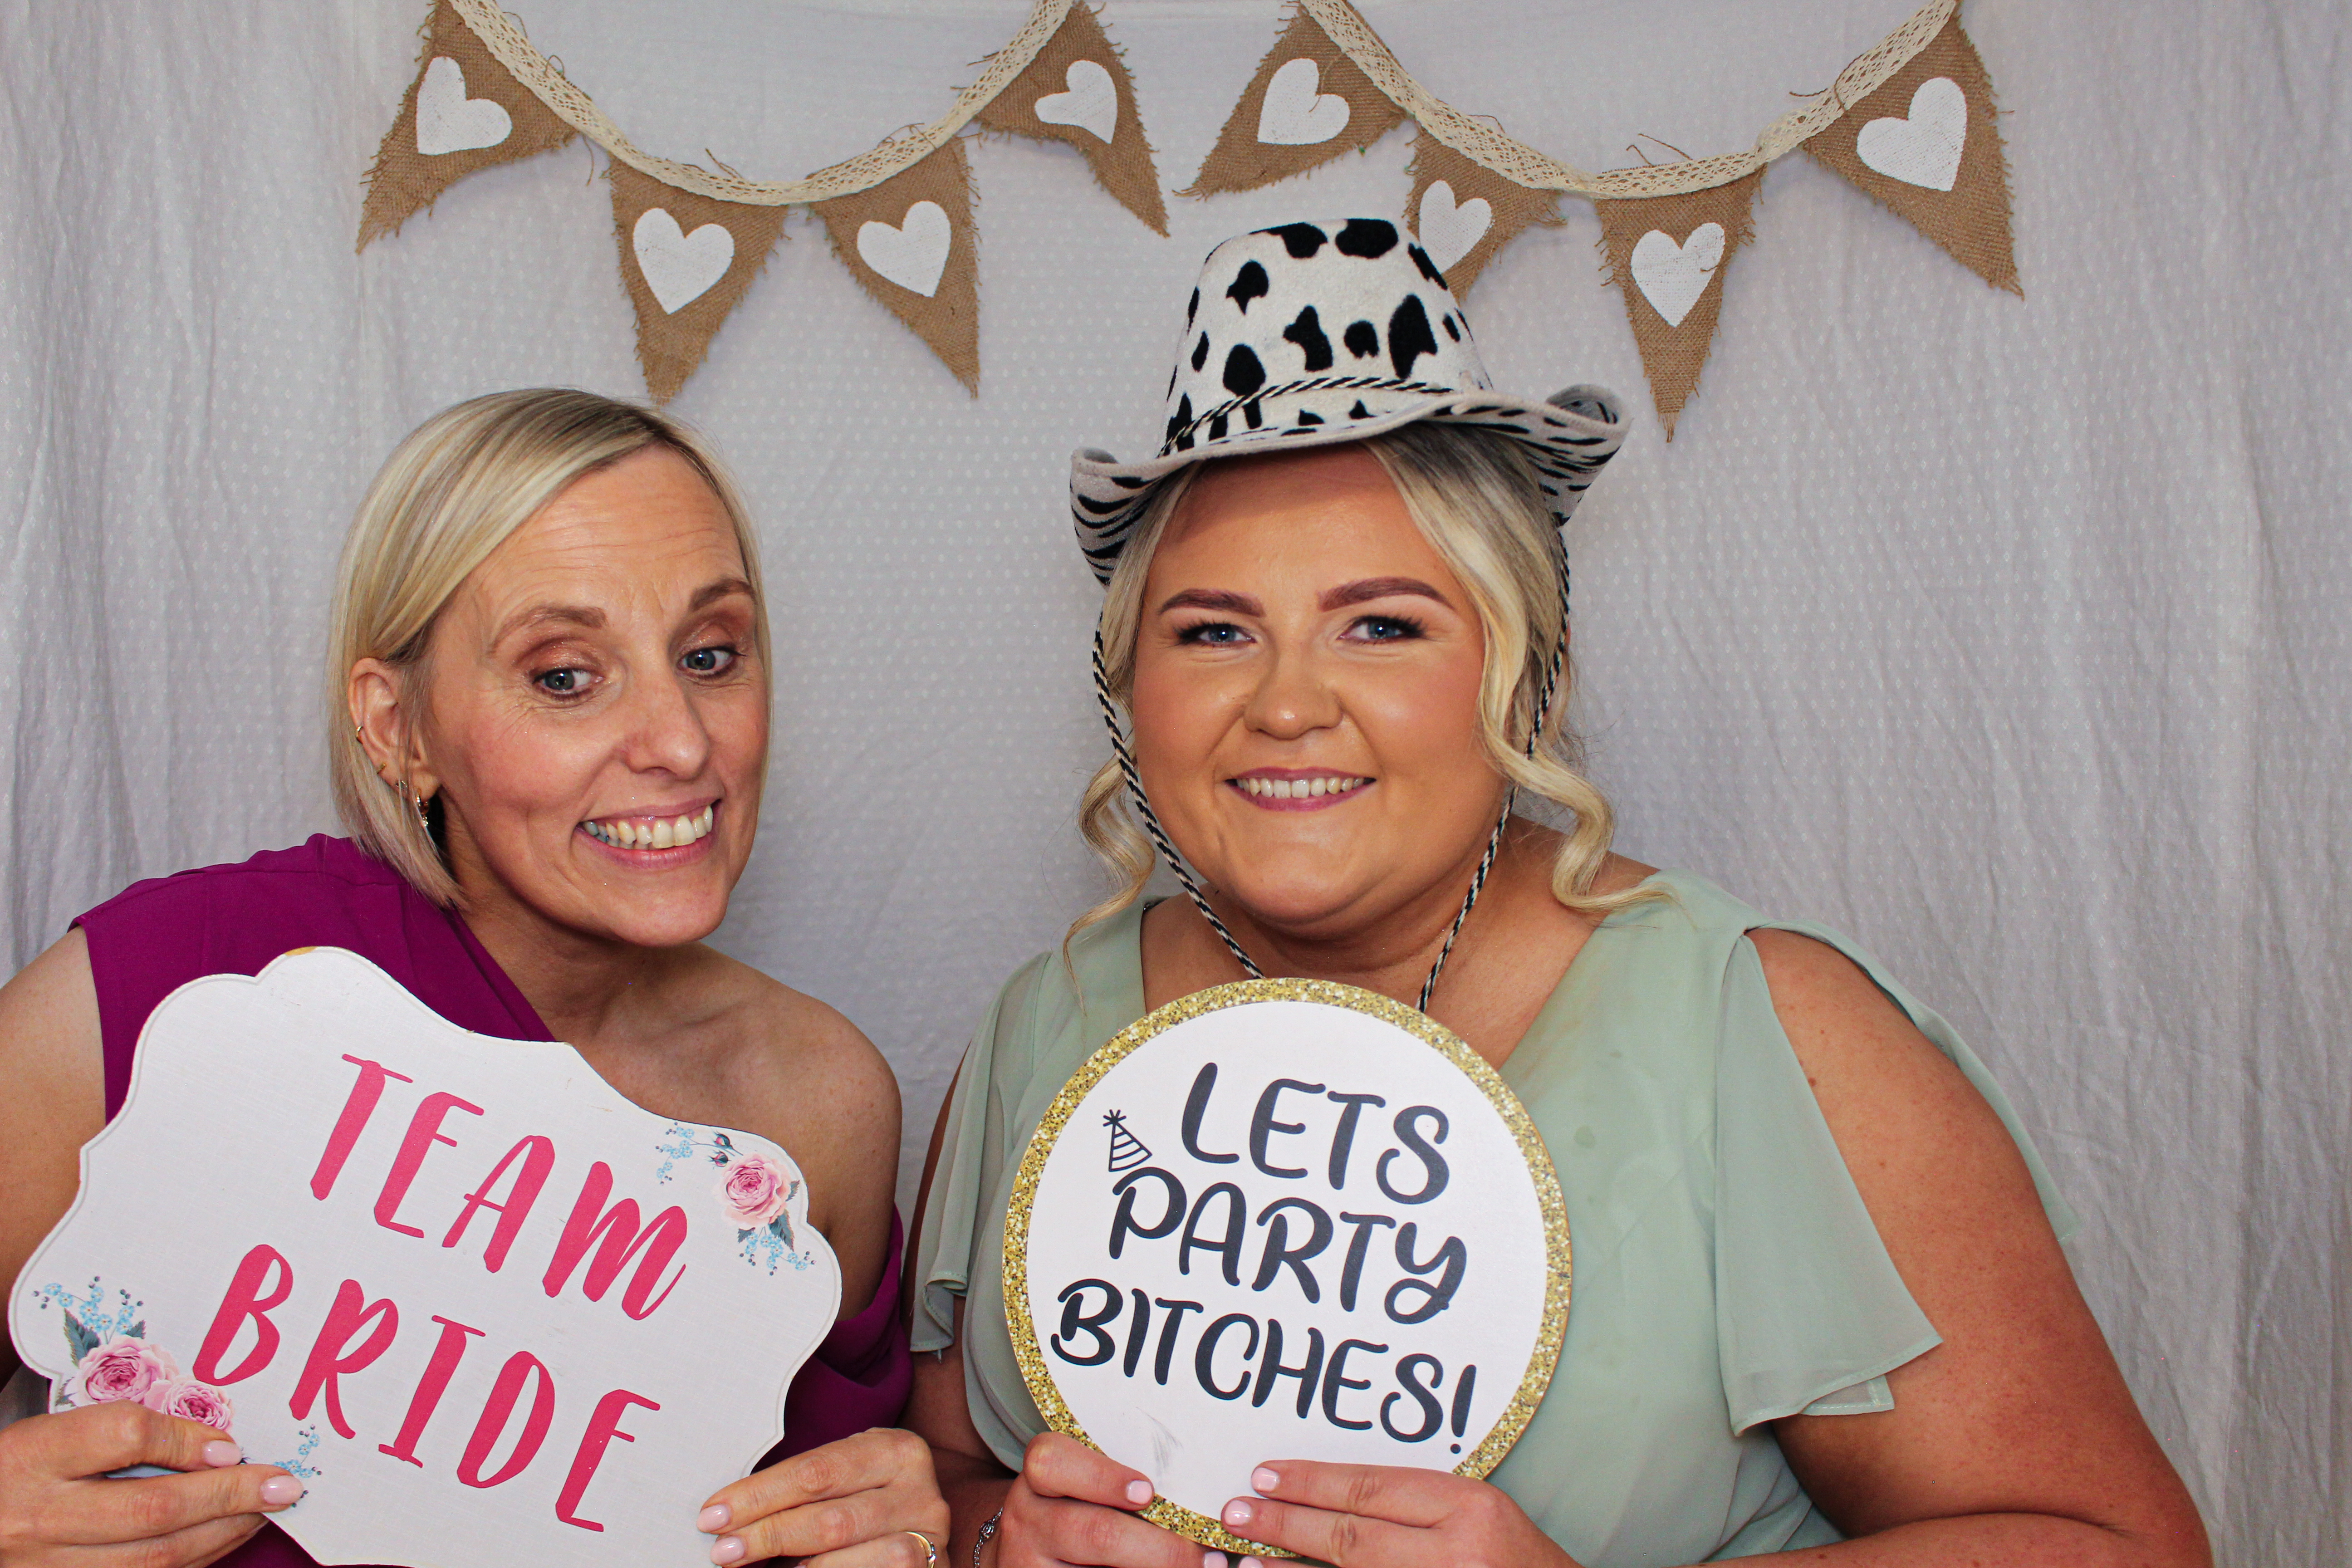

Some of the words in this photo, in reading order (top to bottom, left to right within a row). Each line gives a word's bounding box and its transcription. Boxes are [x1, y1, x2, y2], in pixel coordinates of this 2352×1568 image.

[309, 1054, 687, 1321] TEAM
[1181, 1062, 1450, 1205] LETS
[1109, 1166, 1467, 1324] PARTY
[192, 1244, 661, 1532] BRIDE
[1050, 1278, 1477, 1455] BITCHES!
